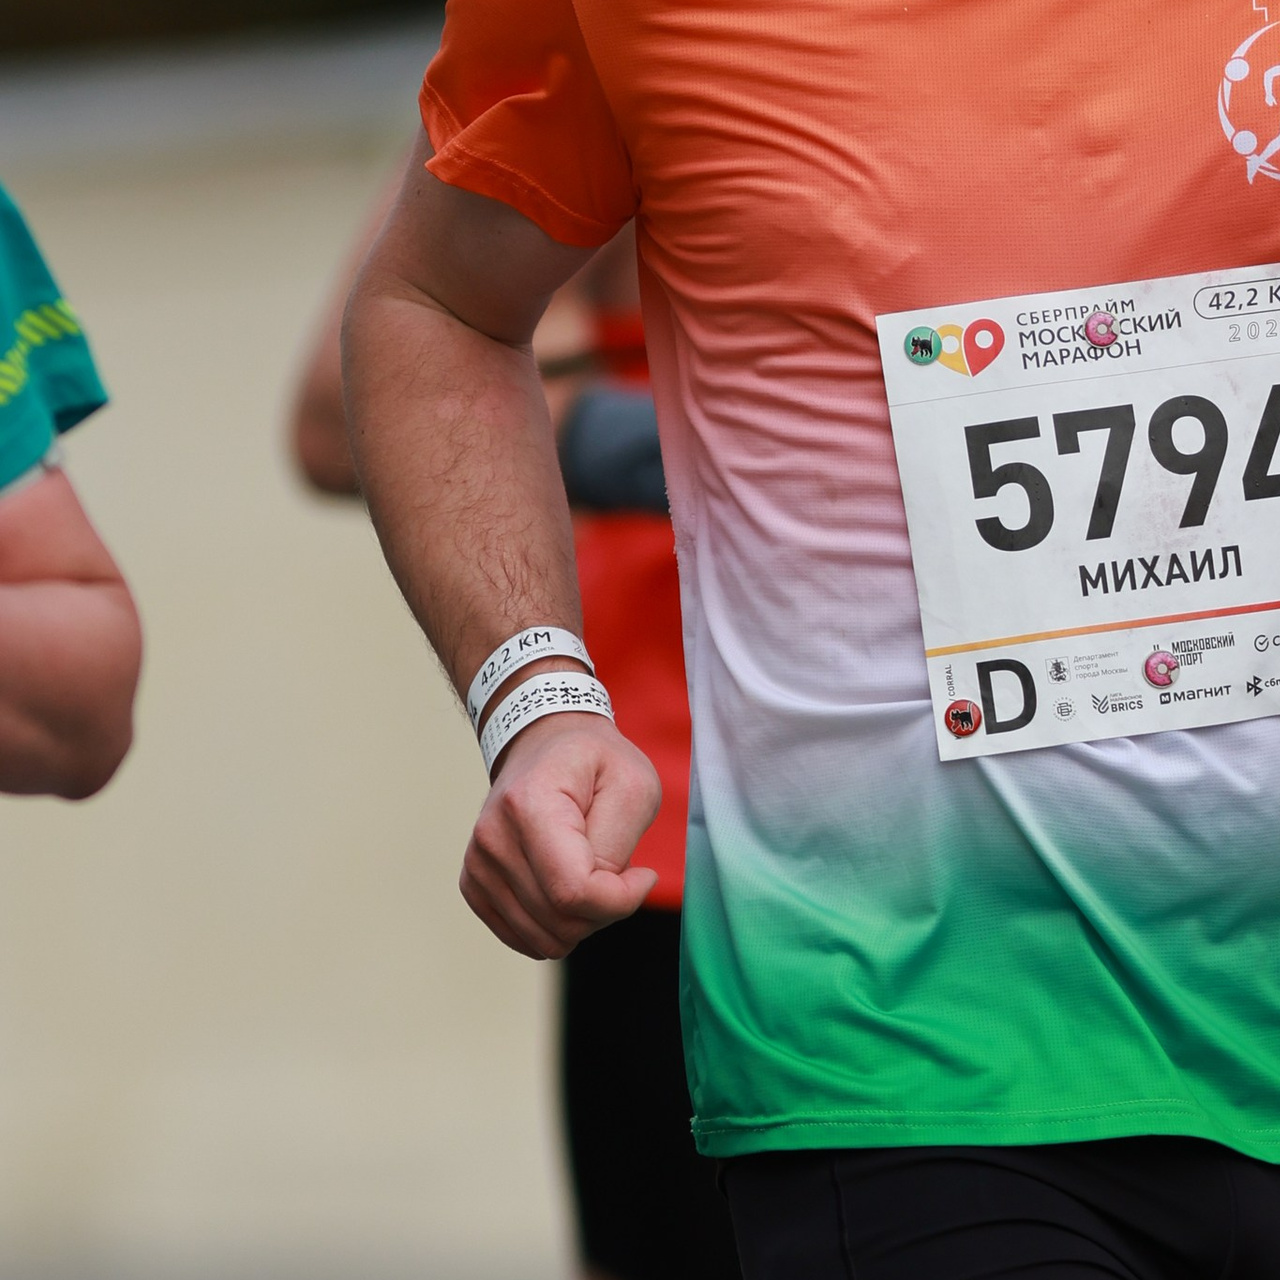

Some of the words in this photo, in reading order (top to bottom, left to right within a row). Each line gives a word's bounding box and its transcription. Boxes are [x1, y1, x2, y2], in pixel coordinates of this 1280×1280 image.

[1208, 287, 1259, 311] 42,2
[1018, 308, 1183, 349] МОСКСКИЙ
[1022, 339, 1142, 370] МАРАФОН
[1078, 545, 1243, 597] МИХАИЛ
[1171, 631, 1235, 654] МОСКОВСКИЙ
[481, 648, 512, 688] 42,2
[1073, 651, 1119, 663] Департамент
[1074, 663, 1099, 672] спорта
[945, 664, 956, 697] CORRAL
[1075, 671, 1100, 680] города
[1101, 667, 1128, 677] Москвы
[976, 658, 1037, 735] D
[1173, 685, 1232, 702] магнит
[1111, 700, 1144, 713] BRICS
